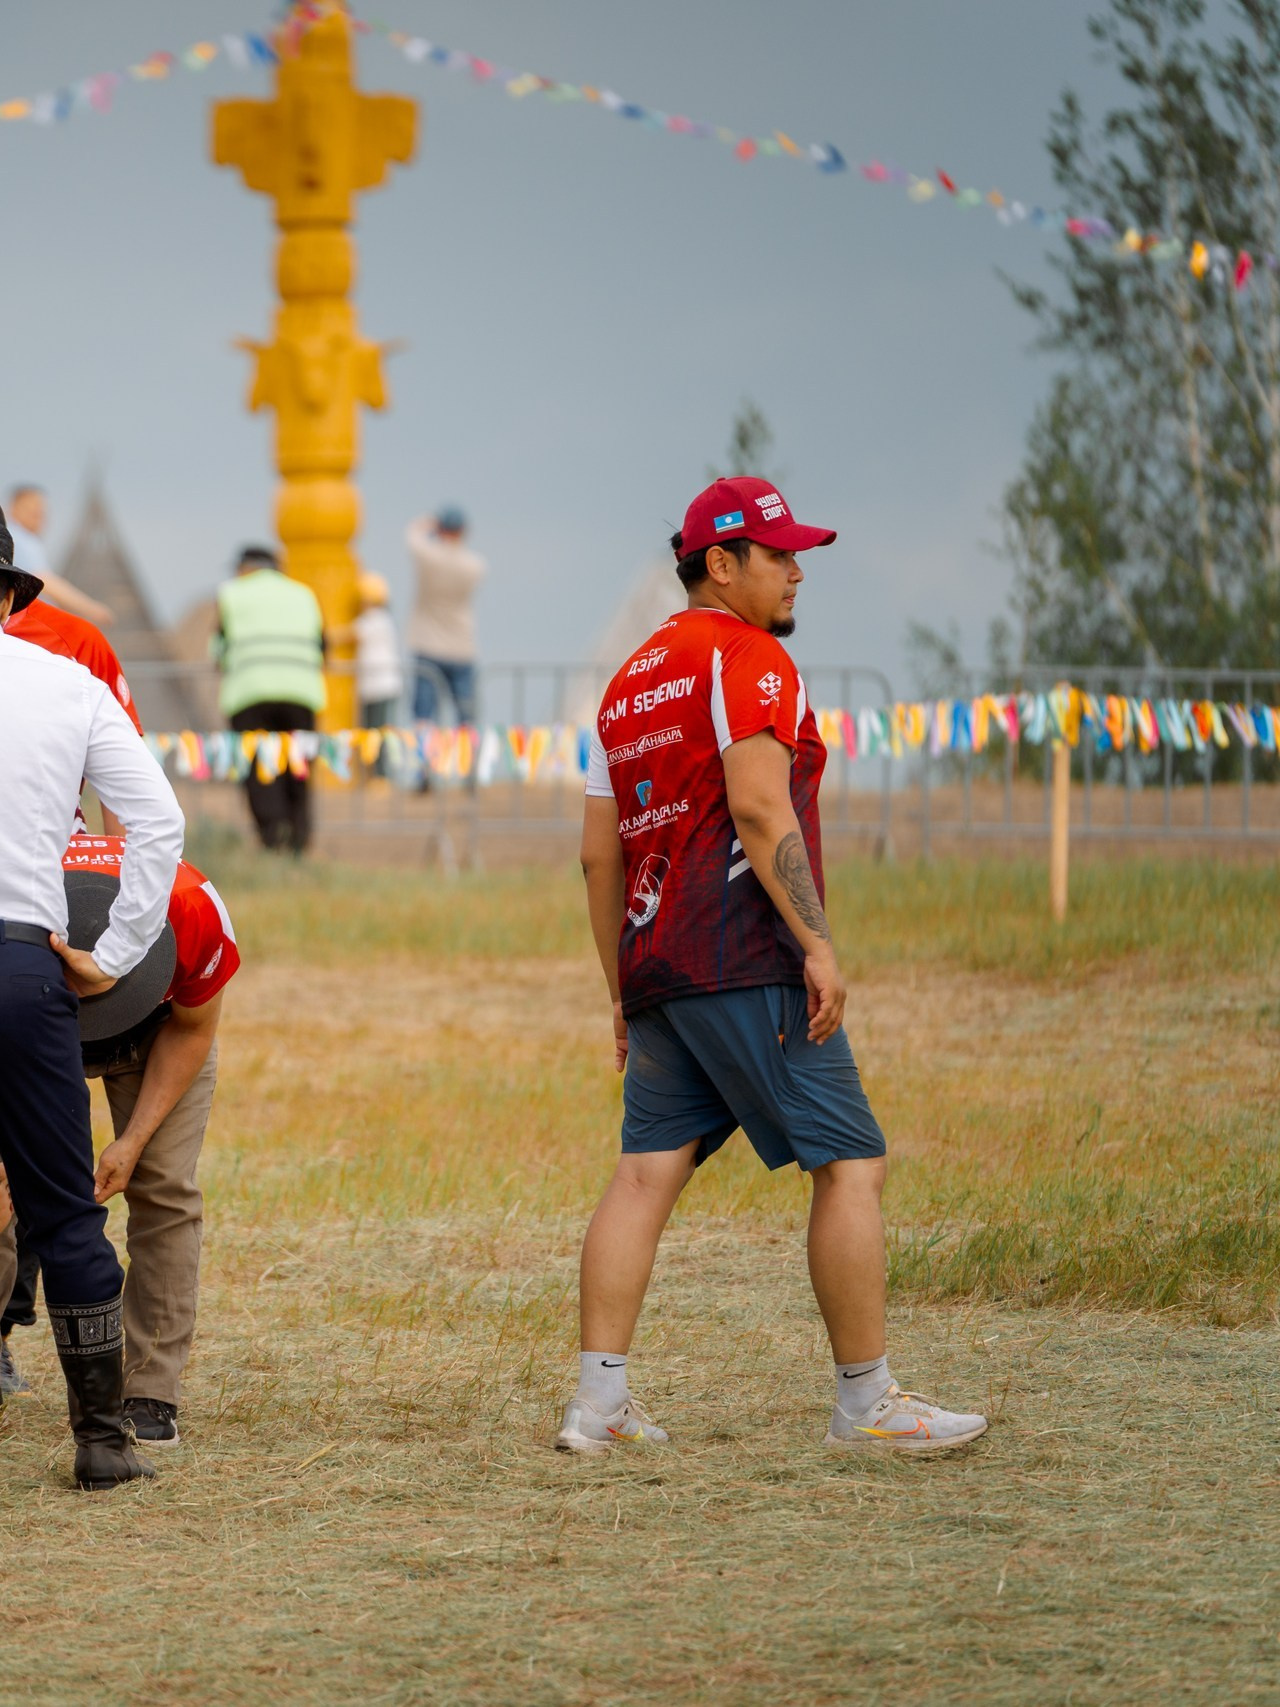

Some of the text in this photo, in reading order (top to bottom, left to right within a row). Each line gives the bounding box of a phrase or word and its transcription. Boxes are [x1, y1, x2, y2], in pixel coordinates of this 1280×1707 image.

[762, 504, 787, 521] СПОРТ
[627, 650, 669, 677] ДЭГИТ
[644, 728, 683, 749] АНАБАРА
[618, 798, 690, 834] АХАНРДСНАБ
